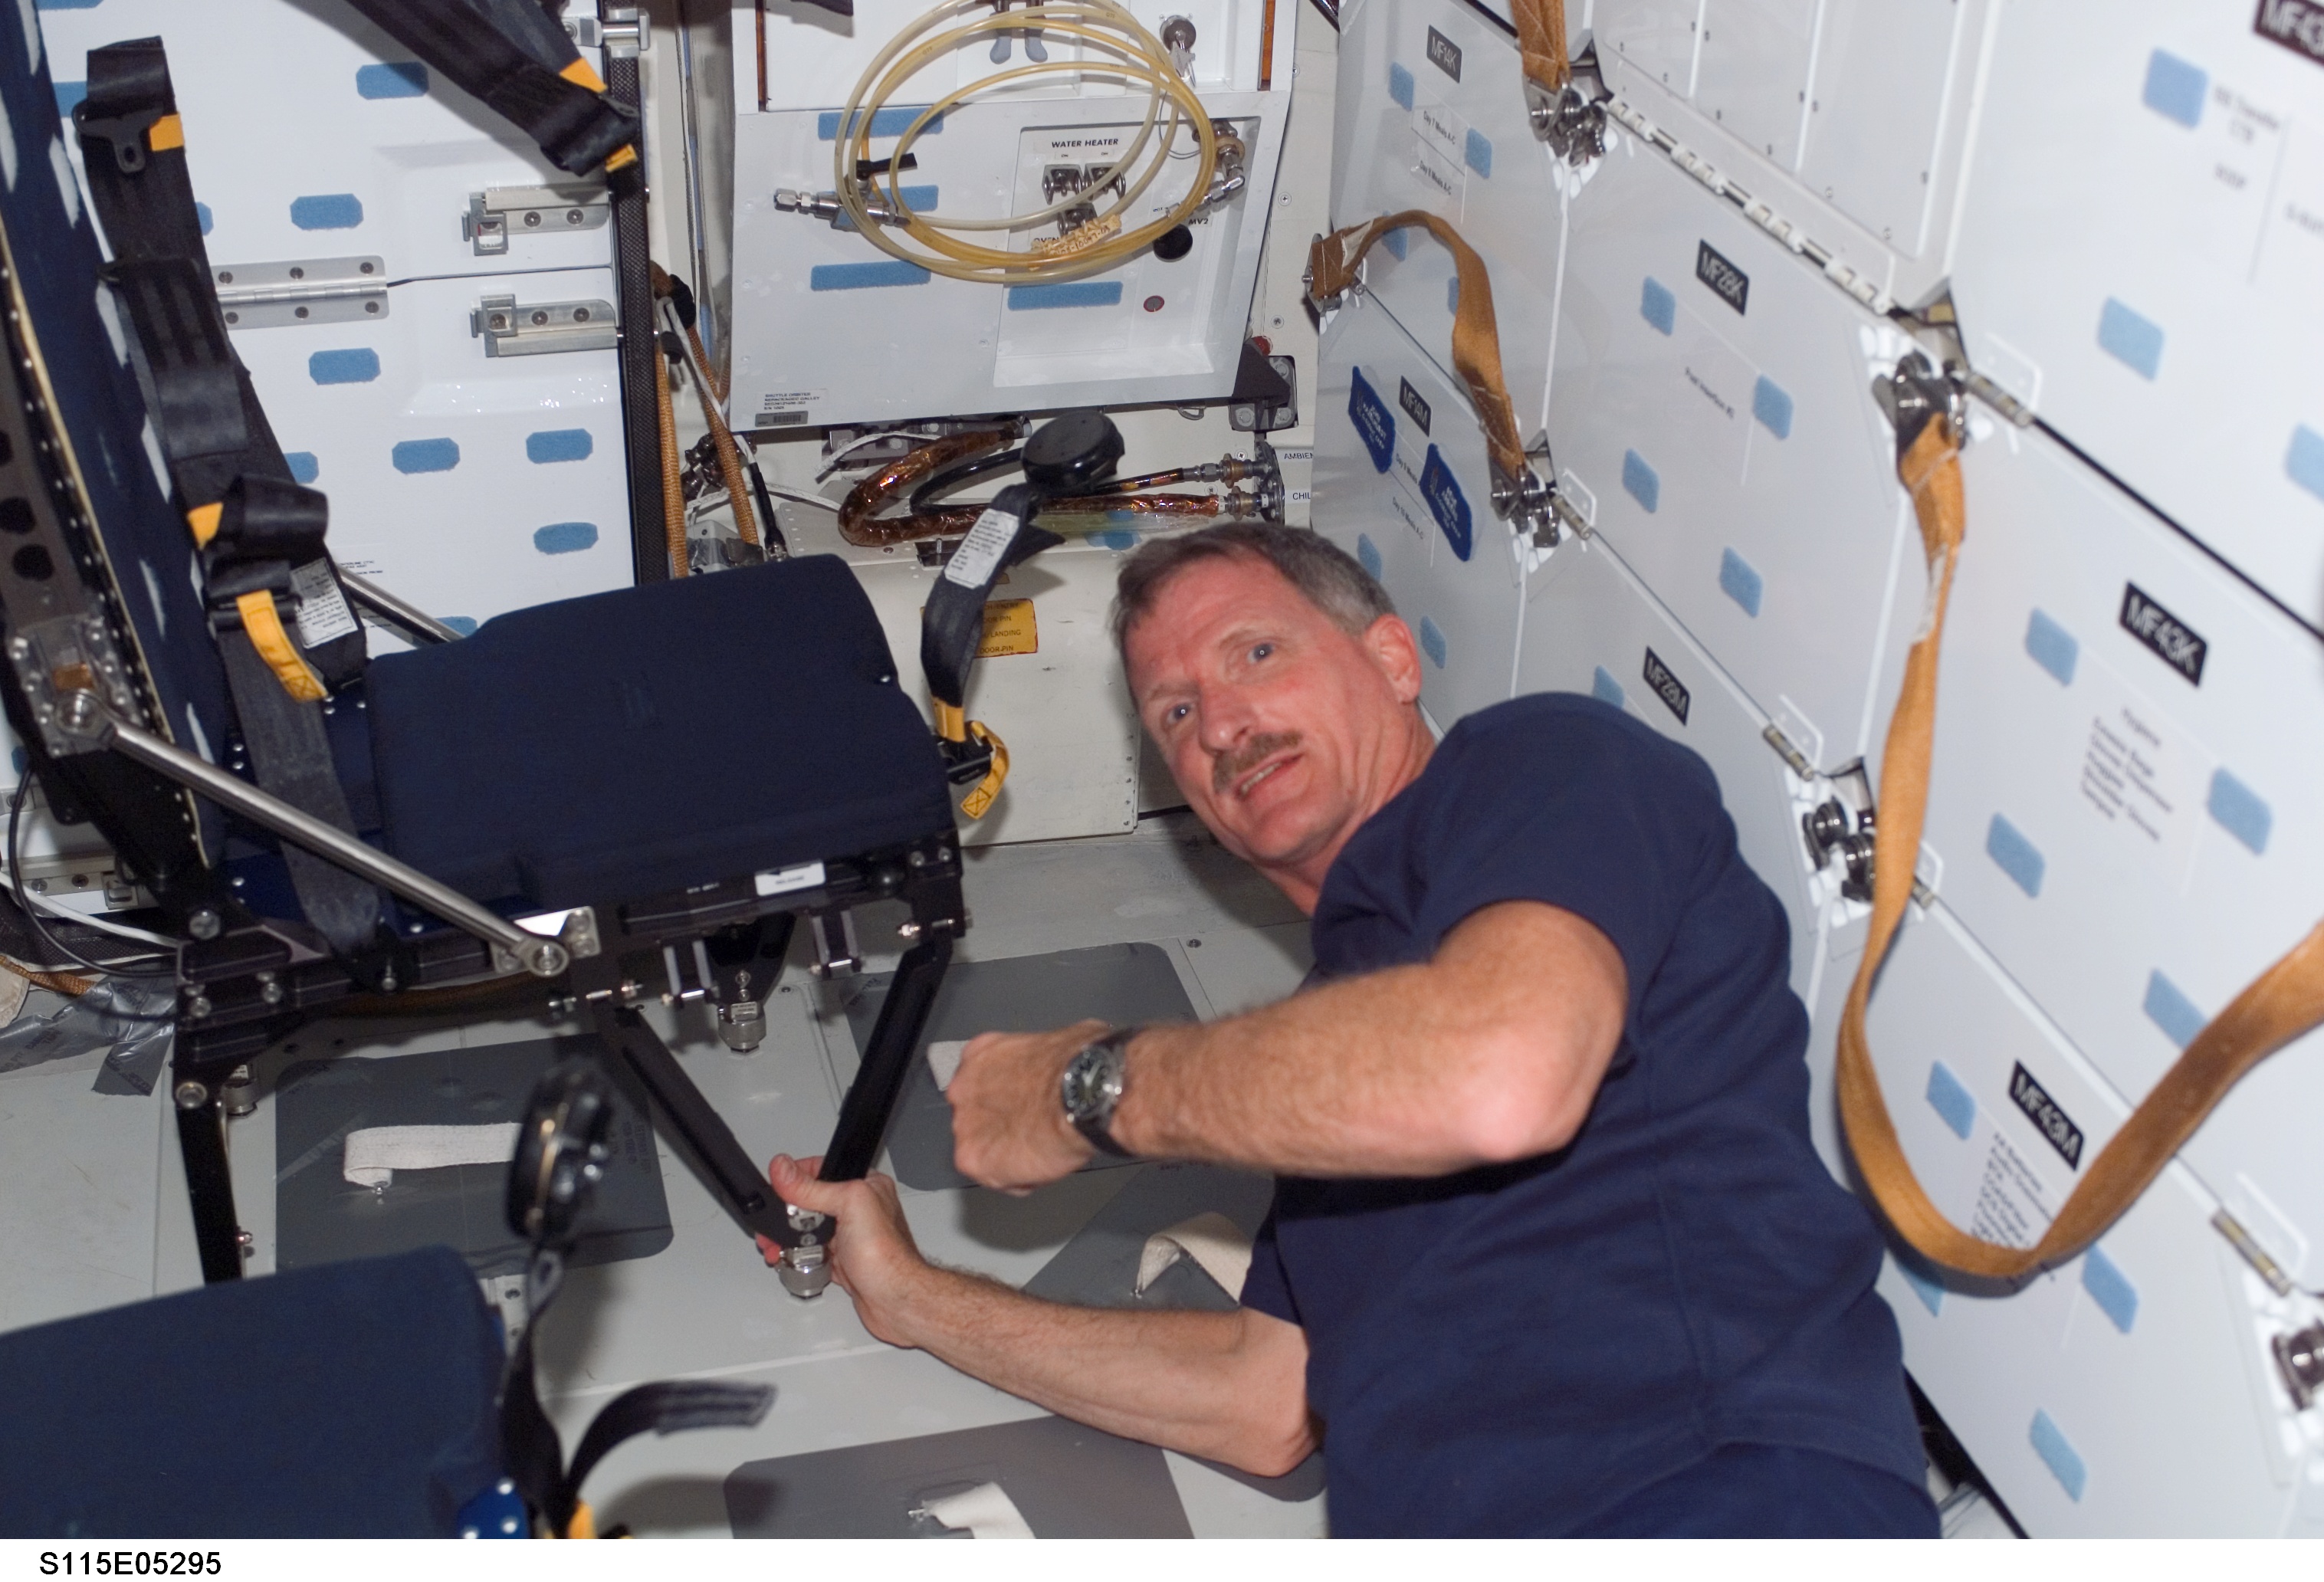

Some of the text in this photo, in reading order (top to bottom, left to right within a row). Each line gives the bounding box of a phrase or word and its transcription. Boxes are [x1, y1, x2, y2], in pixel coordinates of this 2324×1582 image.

[1431, 36, 1456, 72] MF14K
[1052, 138, 1119, 148] WATER HEATER
[1403, 386, 1429, 428] MF14M
